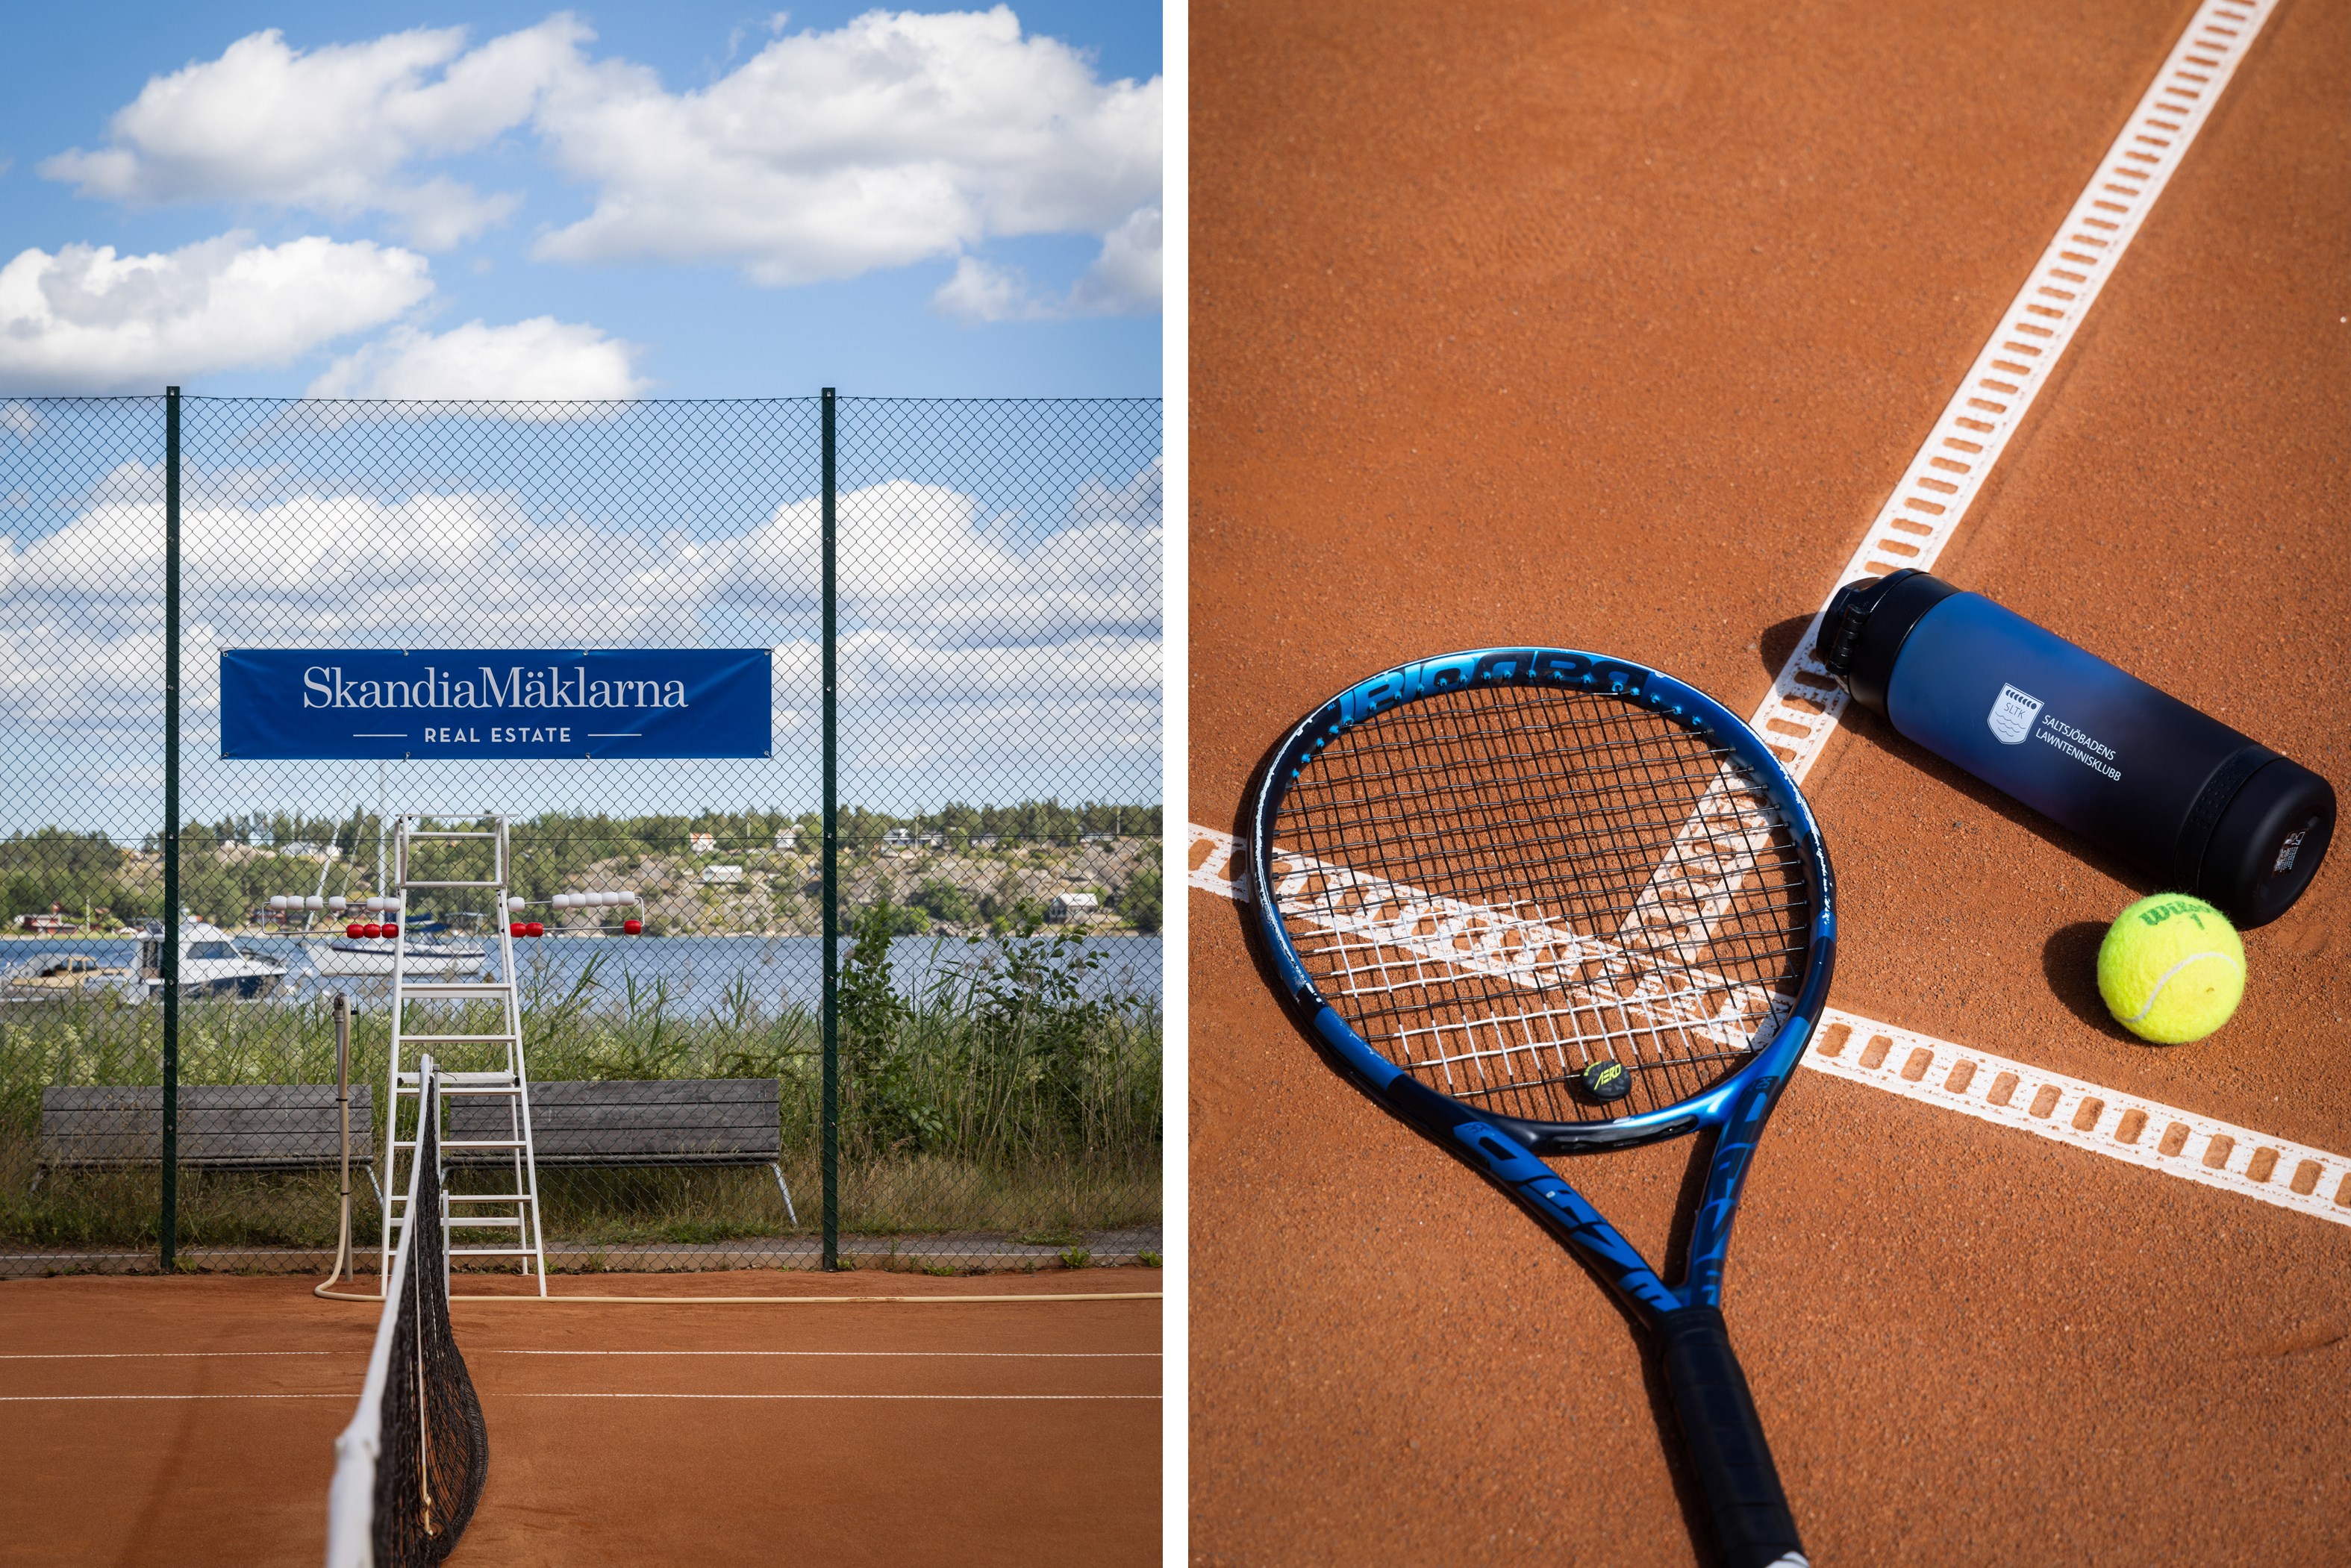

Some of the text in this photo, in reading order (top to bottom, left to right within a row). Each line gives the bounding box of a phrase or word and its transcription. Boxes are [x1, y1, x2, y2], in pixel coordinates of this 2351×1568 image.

[303, 666, 690, 709] SkandiaMäklarna
[2003, 702, 2026, 720] SLTK
[424, 727, 571, 743] REAL ESTATE
[2035, 728, 2122, 781] LAWNTENNISKLUBB
[2041, 714, 2117, 761] SALTSJÖBADENS
